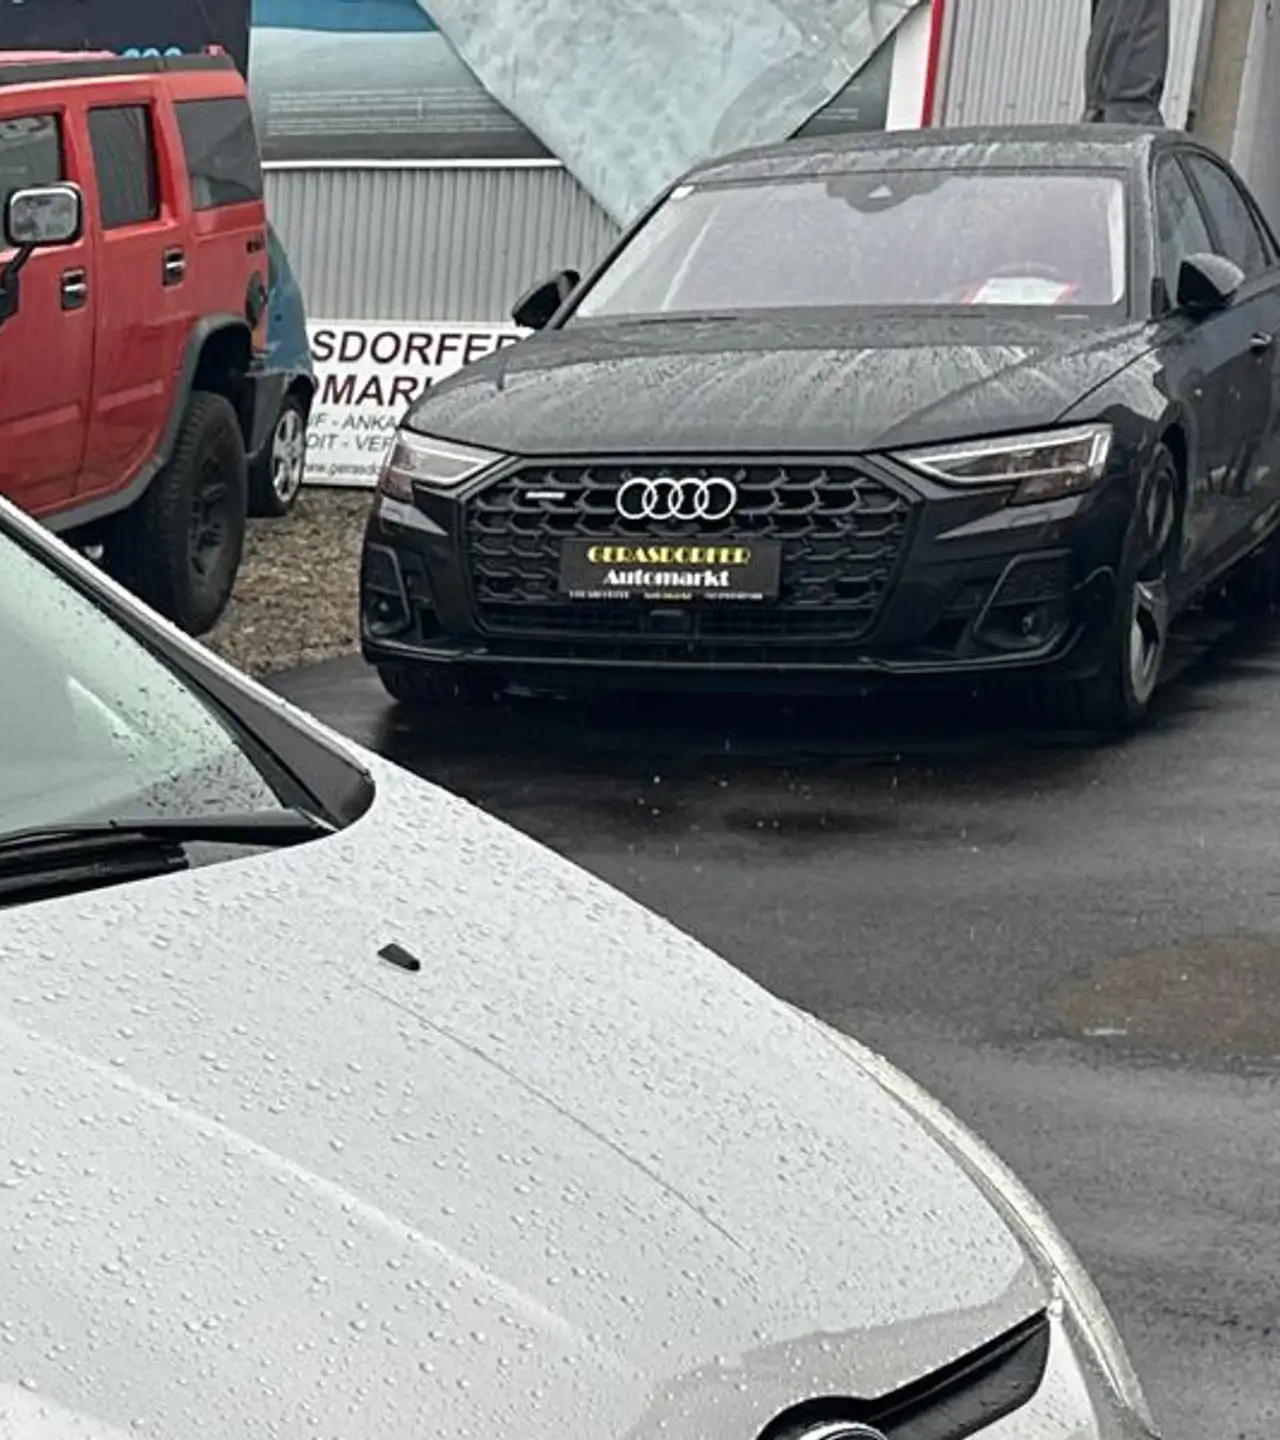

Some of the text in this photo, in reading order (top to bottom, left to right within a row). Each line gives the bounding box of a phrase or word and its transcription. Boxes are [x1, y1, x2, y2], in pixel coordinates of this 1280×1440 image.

[321, 374, 432, 407] MAR
[587, 547, 751, 564] GERASDORFER
[603, 568, 730, 588] Automarkt
